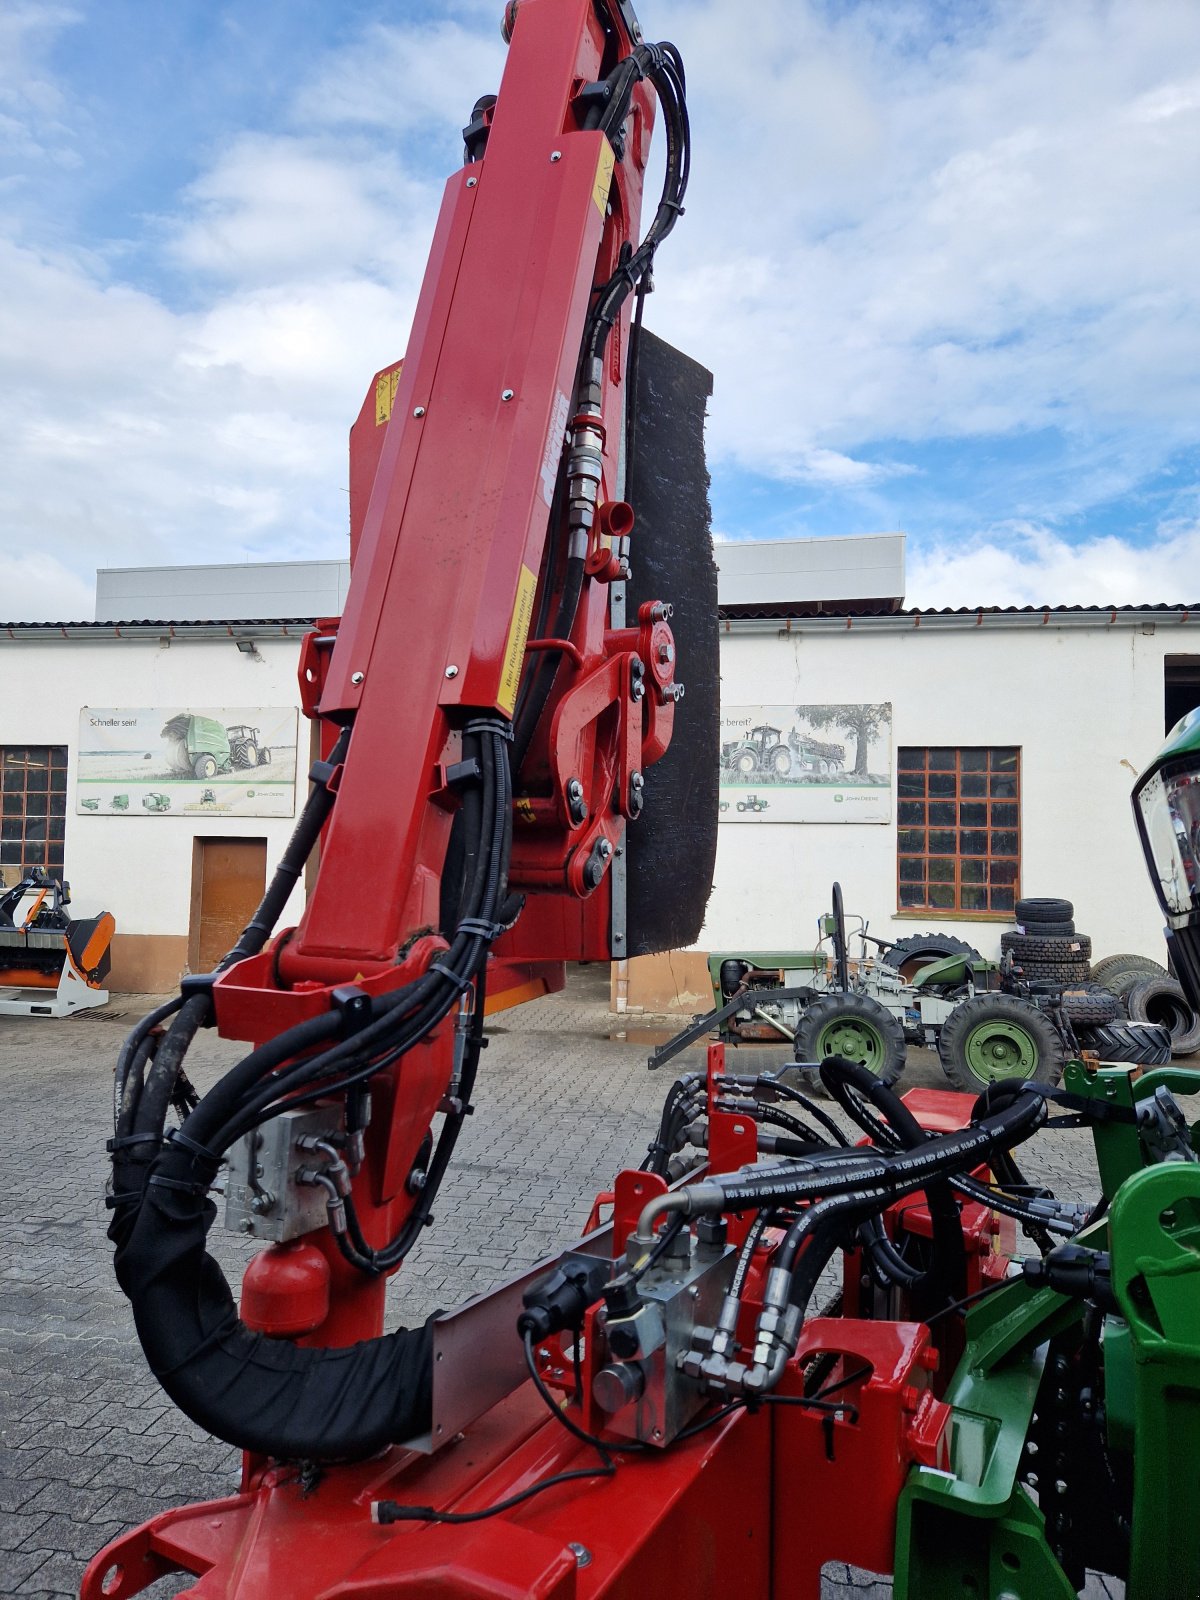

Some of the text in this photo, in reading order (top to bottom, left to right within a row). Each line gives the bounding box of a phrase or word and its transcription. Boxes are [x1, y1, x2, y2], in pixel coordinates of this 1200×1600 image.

[505, 670, 514, 688] Bei
[90, 718, 137, 727] Schneller sein!
[726, 717, 752, 727] bereit?
[936, 1150, 946, 1159] WP
[901, 1160, 913, 1169] ISO
[912, 1157, 926, 1167] BAR
[846, 1170, 875, 1182] EXCEEDS
[786, 1182, 797, 1192] EN
[796, 1174, 846, 1190] PERFORMANCE
[725, 1189, 739, 1199] 100
[739, 1187, 756, 1198] SAE
[759, 1186, 773, 1196] 4SP
[730, 1259, 747, 1298] EXCEEDS
[741, 1248, 751, 1260] EN
